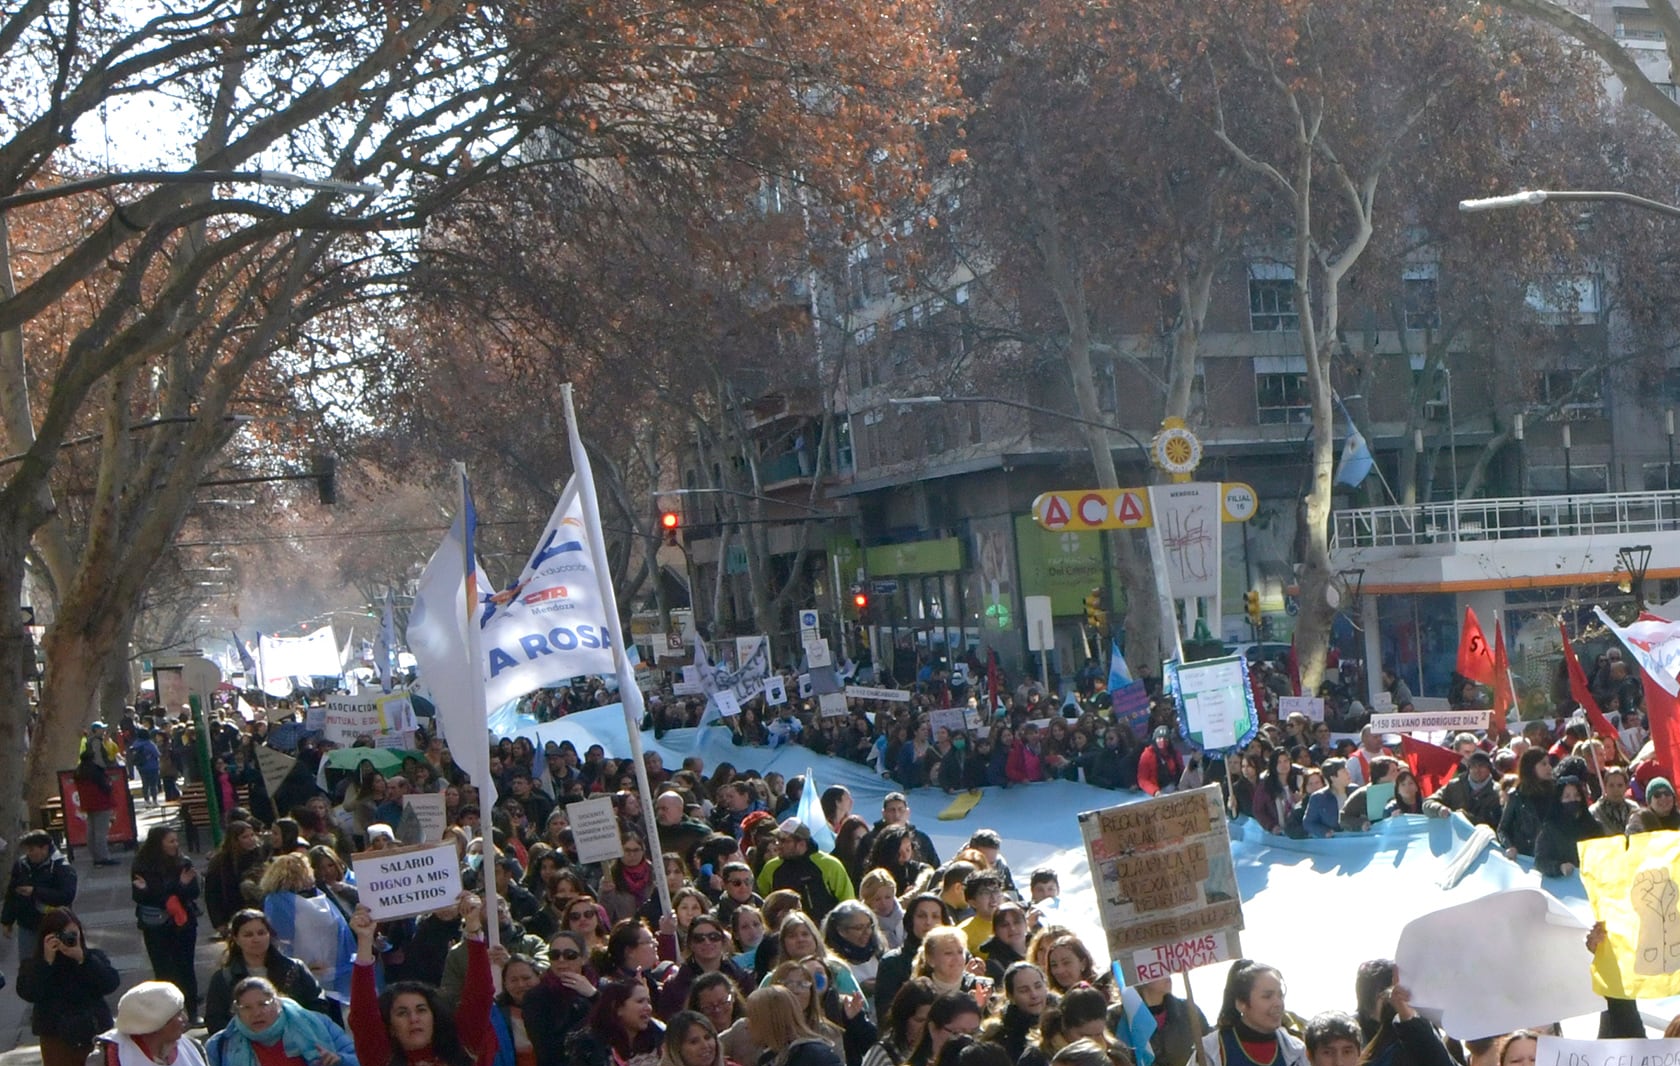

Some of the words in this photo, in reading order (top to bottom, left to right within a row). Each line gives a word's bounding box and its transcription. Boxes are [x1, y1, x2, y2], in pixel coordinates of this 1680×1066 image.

[1170, 490, 1199, 498] MENDOZA
[1226, 494, 1251, 503] FILIAL
[1044, 492, 1143, 526] ACA
[1236, 503, 1245, 511] 16
[531, 602, 575, 616] Mendoza
[328, 702, 378, 713] ASOCIACION
[327, 716, 357, 726] MUTUAL
[1371, 718, 1390, 729] 1-150
[1391, 717, 1421, 728] SILVANO
[380, 855, 435, 873] SALARIO
[369, 876, 412, 893] DIGNO
[415, 874, 425, 885] A
[427, 868, 450, 881] MIS
[379, 886, 447, 907] MAESTROS
[1152, 935, 1217, 961] THOMAS
[1137, 951, 1219, 981] RENUNCIA
